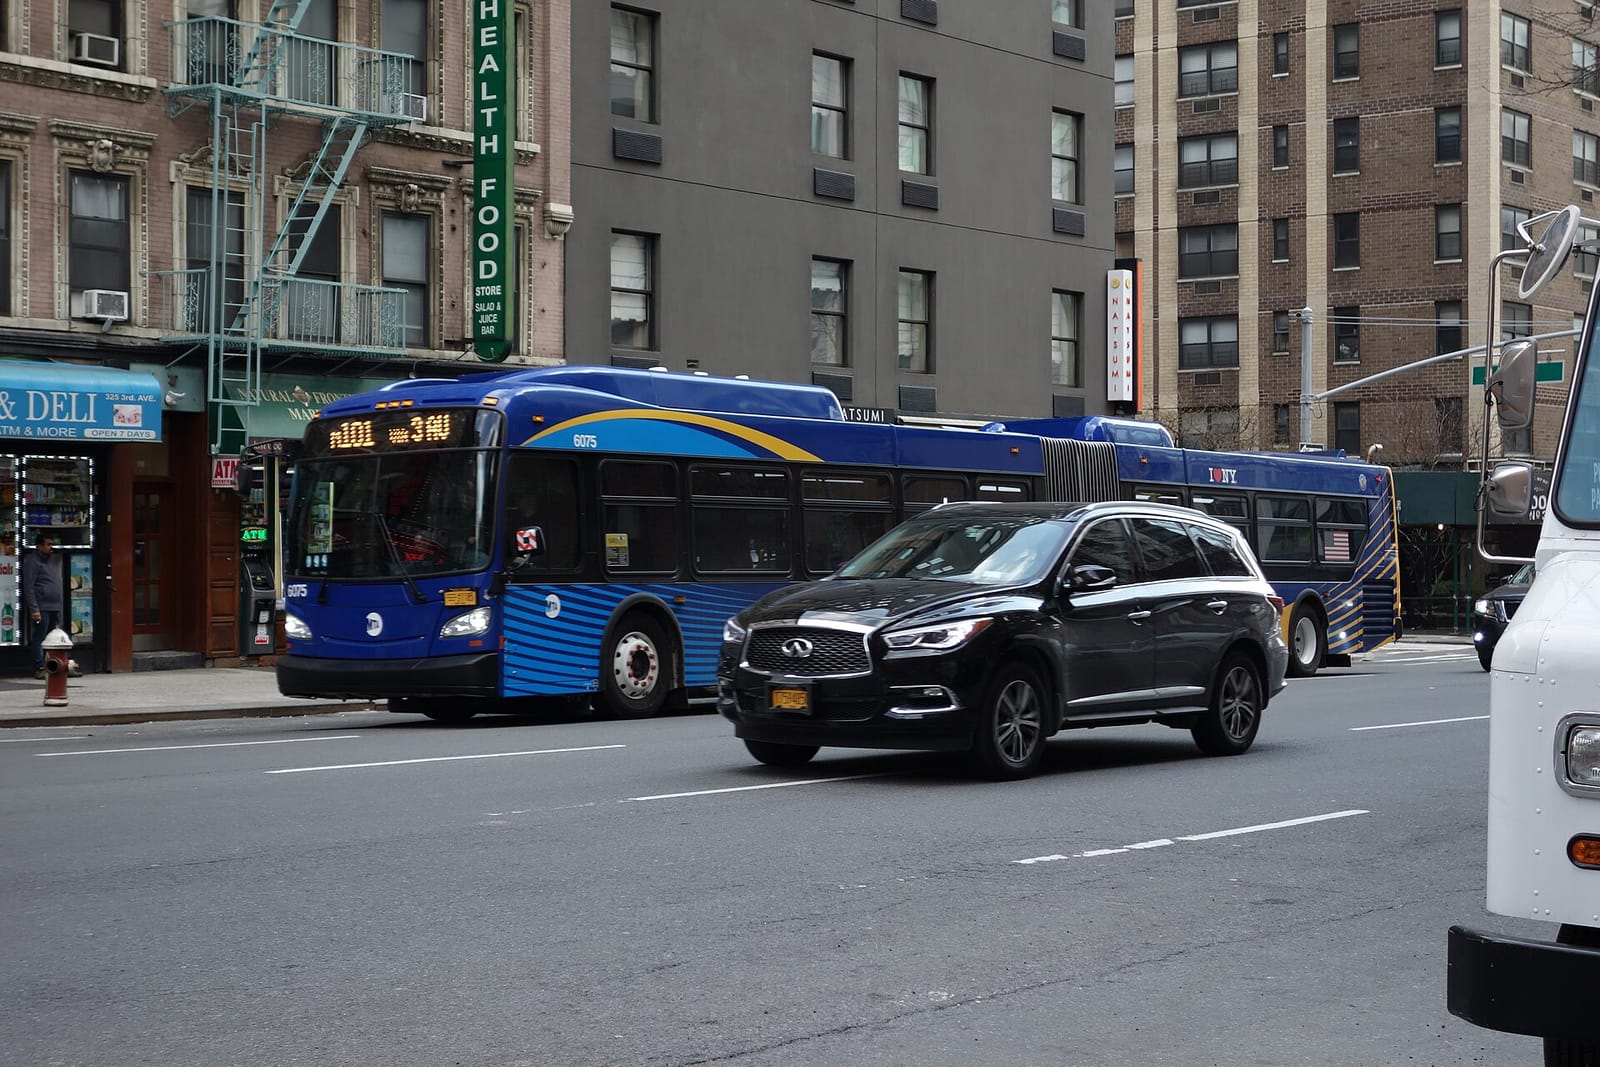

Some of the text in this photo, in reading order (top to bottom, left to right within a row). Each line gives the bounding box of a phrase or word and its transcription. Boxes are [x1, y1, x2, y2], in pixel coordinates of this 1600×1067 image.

[479, 0, 499, 155] HEALTH
[478, 178, 499, 279] FOOD
[475, 285, 501, 296] STORE
[475, 302, 500, 312] SALAD &
[479, 314, 498, 323] JUICE
[481, 326, 494, 335] BAR
[0, 390, 96, 422] & DELI
[0, 426, 76, 437] TM & MORE
[574, 434, 598, 448] 6075
[1222, 468, 1237, 483] NY
[242, 530, 266, 540] ATM
[288, 584, 308, 598] 6075
